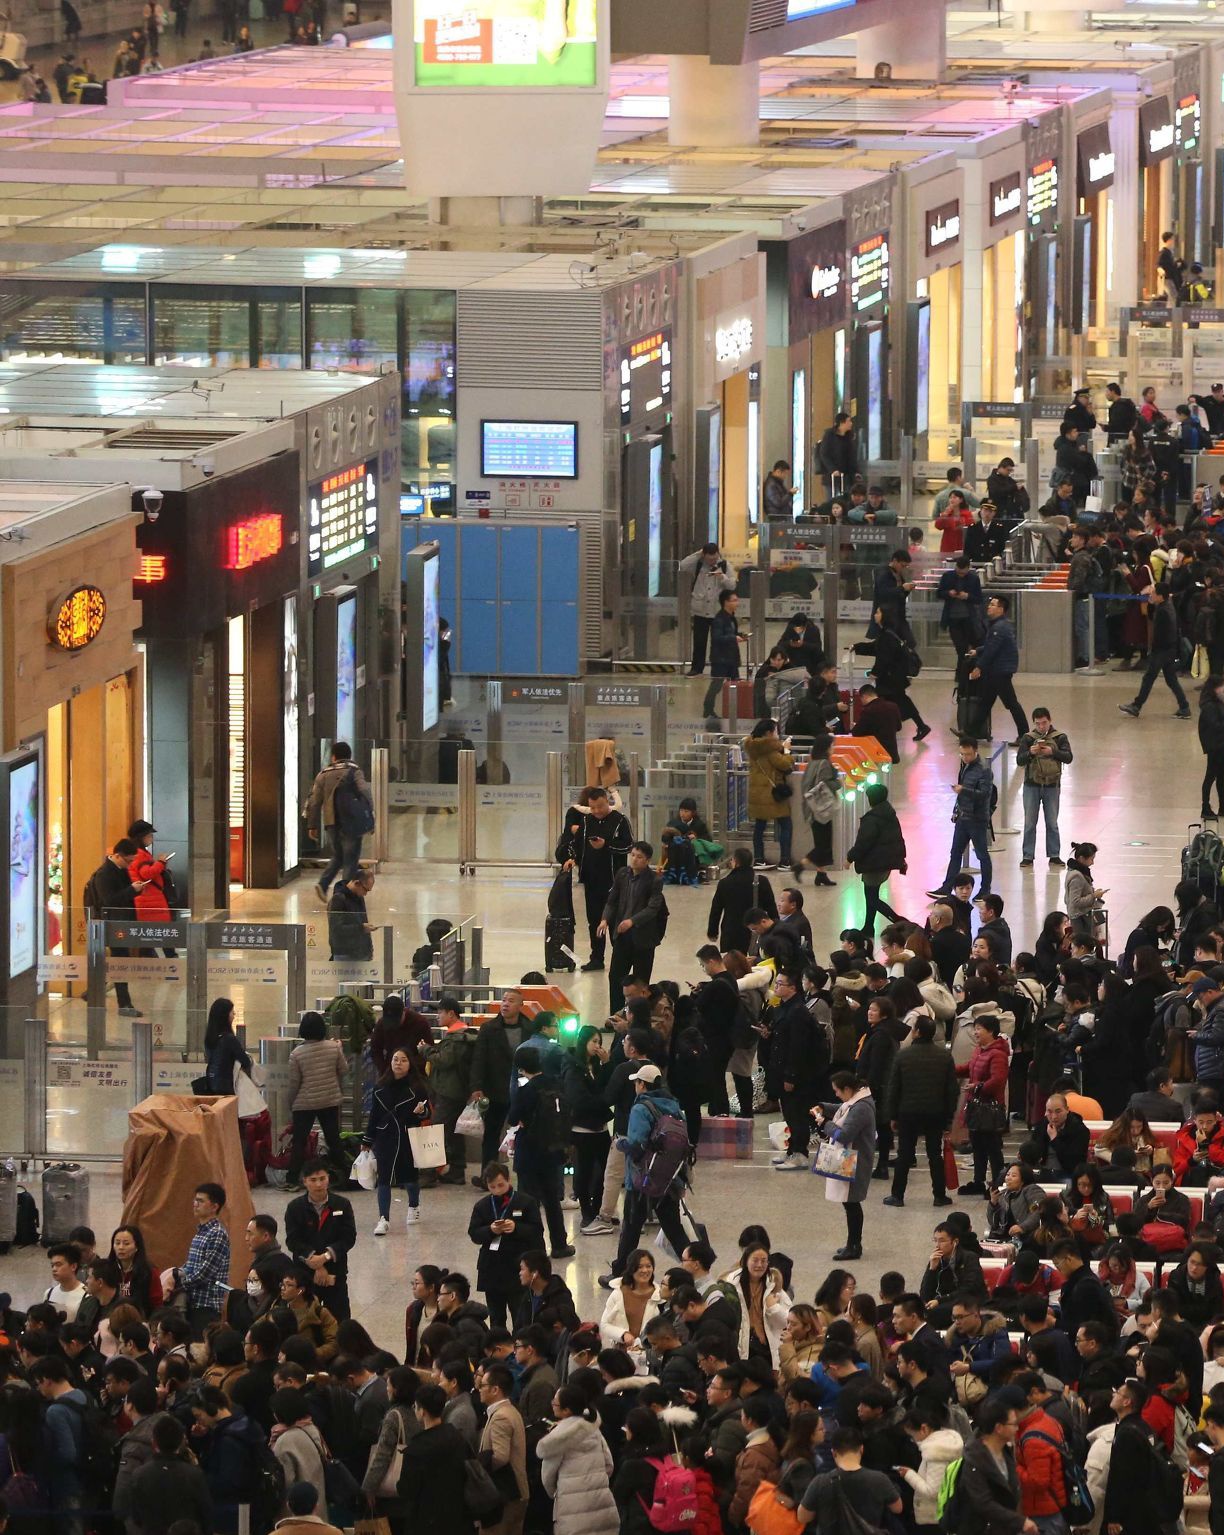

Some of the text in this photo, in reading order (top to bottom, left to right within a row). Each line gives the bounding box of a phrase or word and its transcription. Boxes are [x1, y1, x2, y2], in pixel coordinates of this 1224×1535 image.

[129, 927, 180, 938] 军人依法优先
[221, 935, 273, 944] 重点旅客通道
[98, 1079, 128, 1087] 文明出行
